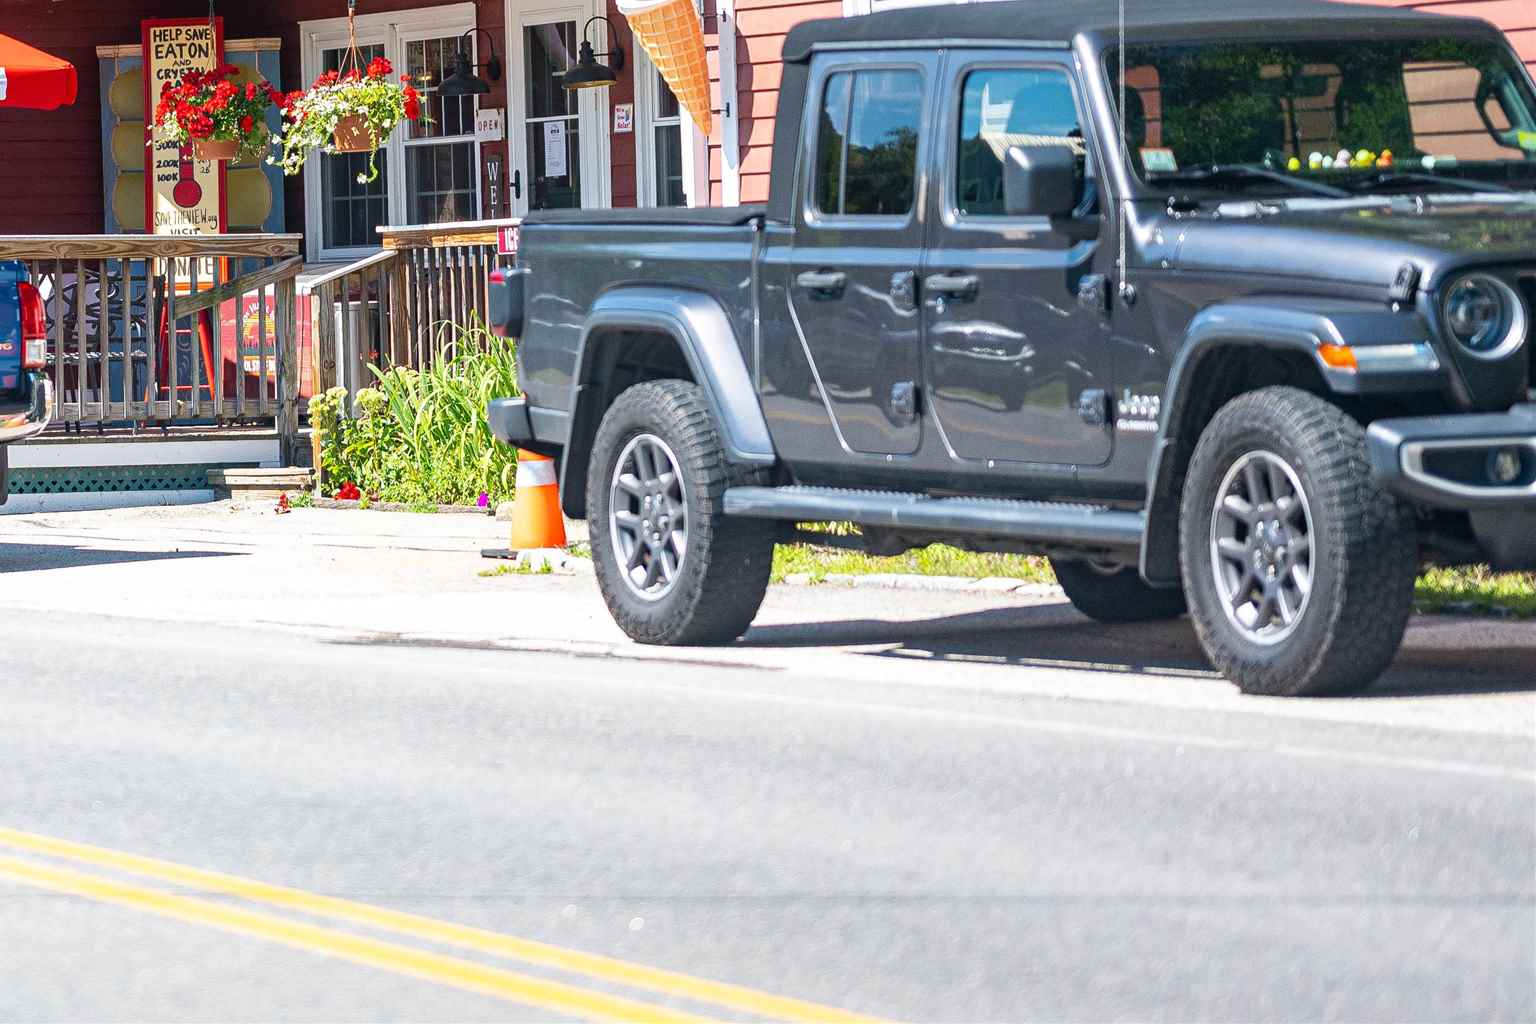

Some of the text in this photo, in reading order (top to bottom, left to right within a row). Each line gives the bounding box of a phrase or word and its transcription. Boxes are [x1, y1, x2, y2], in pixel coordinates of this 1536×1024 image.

[153, 28, 211, 42] HELP SAVE
[155, 42, 209, 59] EATON
[172, 59, 192, 67] AND
[477, 119, 499, 131] OPEN
[156, 159, 179, 169] 200K
[157, 173, 179, 182] 100K
[159, 255, 213, 276] DNTE
